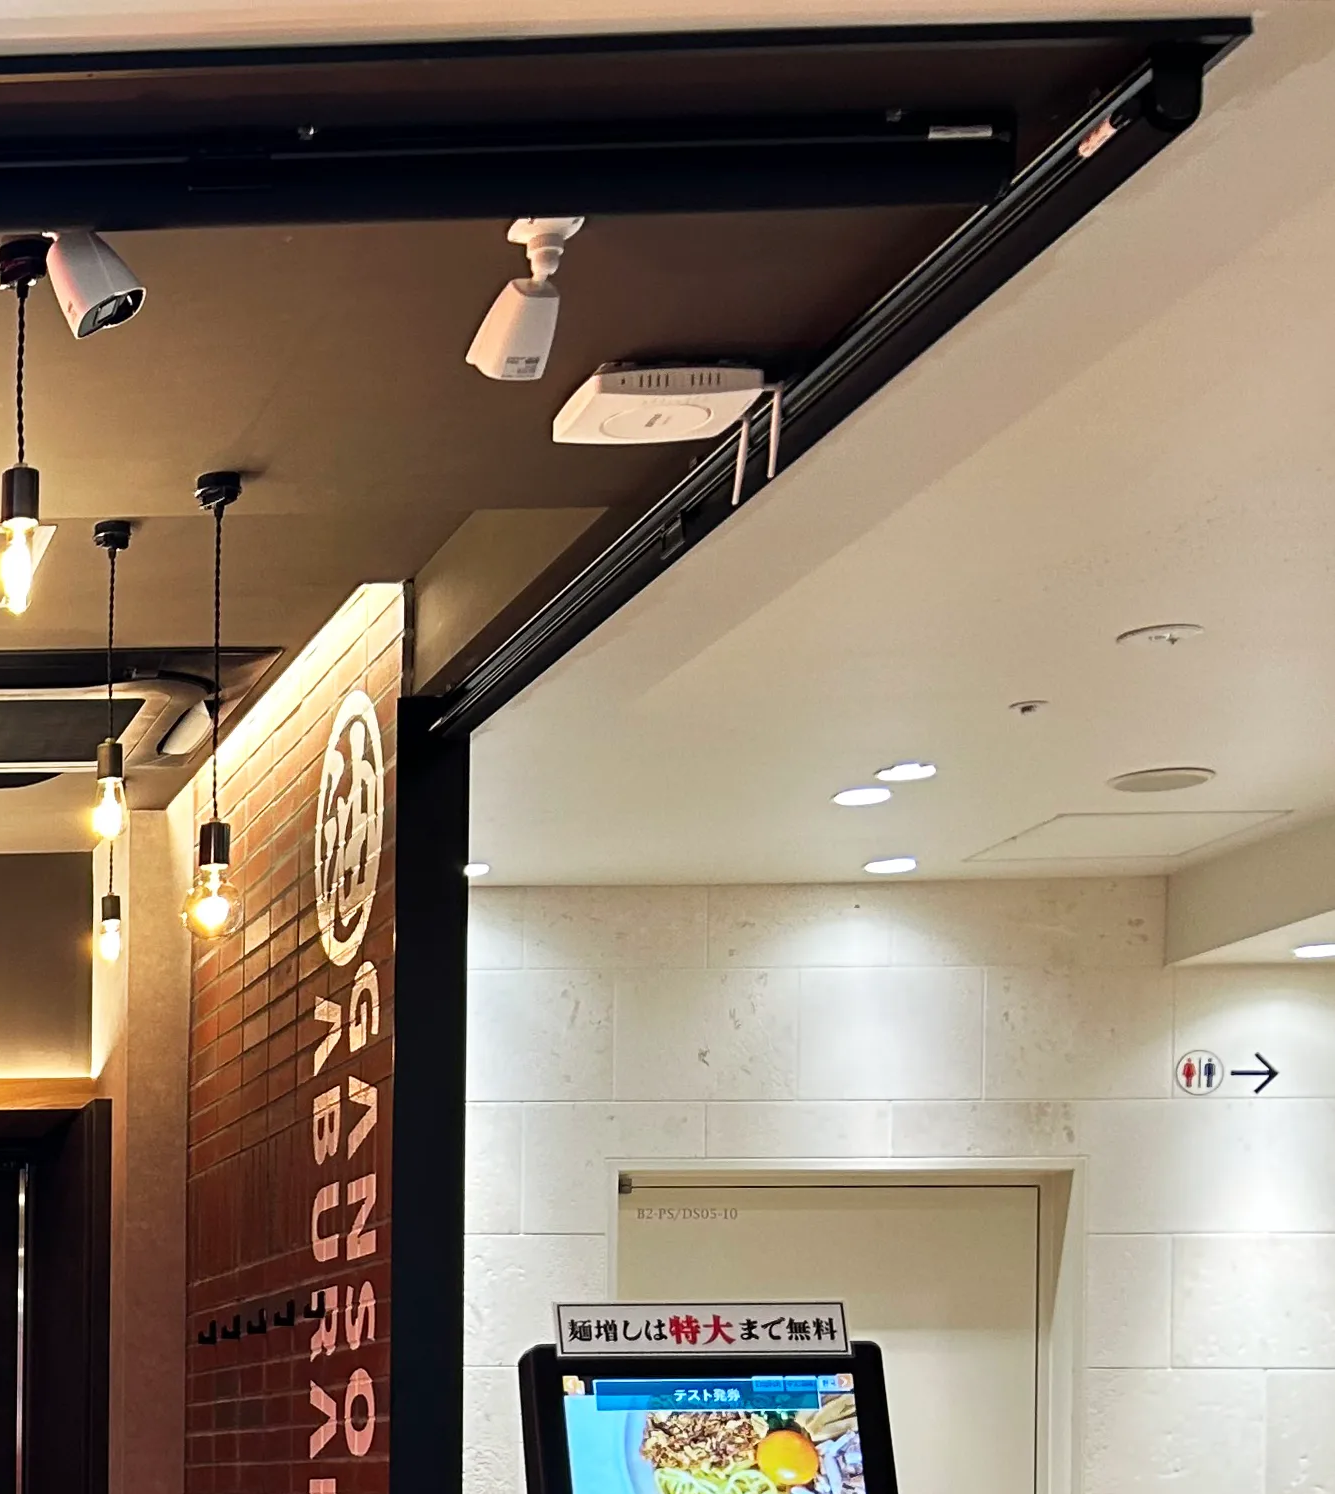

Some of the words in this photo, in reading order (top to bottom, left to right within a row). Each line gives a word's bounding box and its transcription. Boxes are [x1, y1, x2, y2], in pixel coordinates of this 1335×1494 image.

[346, 959, 380, 1457] GANSO
[636, 1207, 739, 1221] B2-PS/DS05-10
[567, 1314, 838, 1346] 麺増しは特大まで無料
